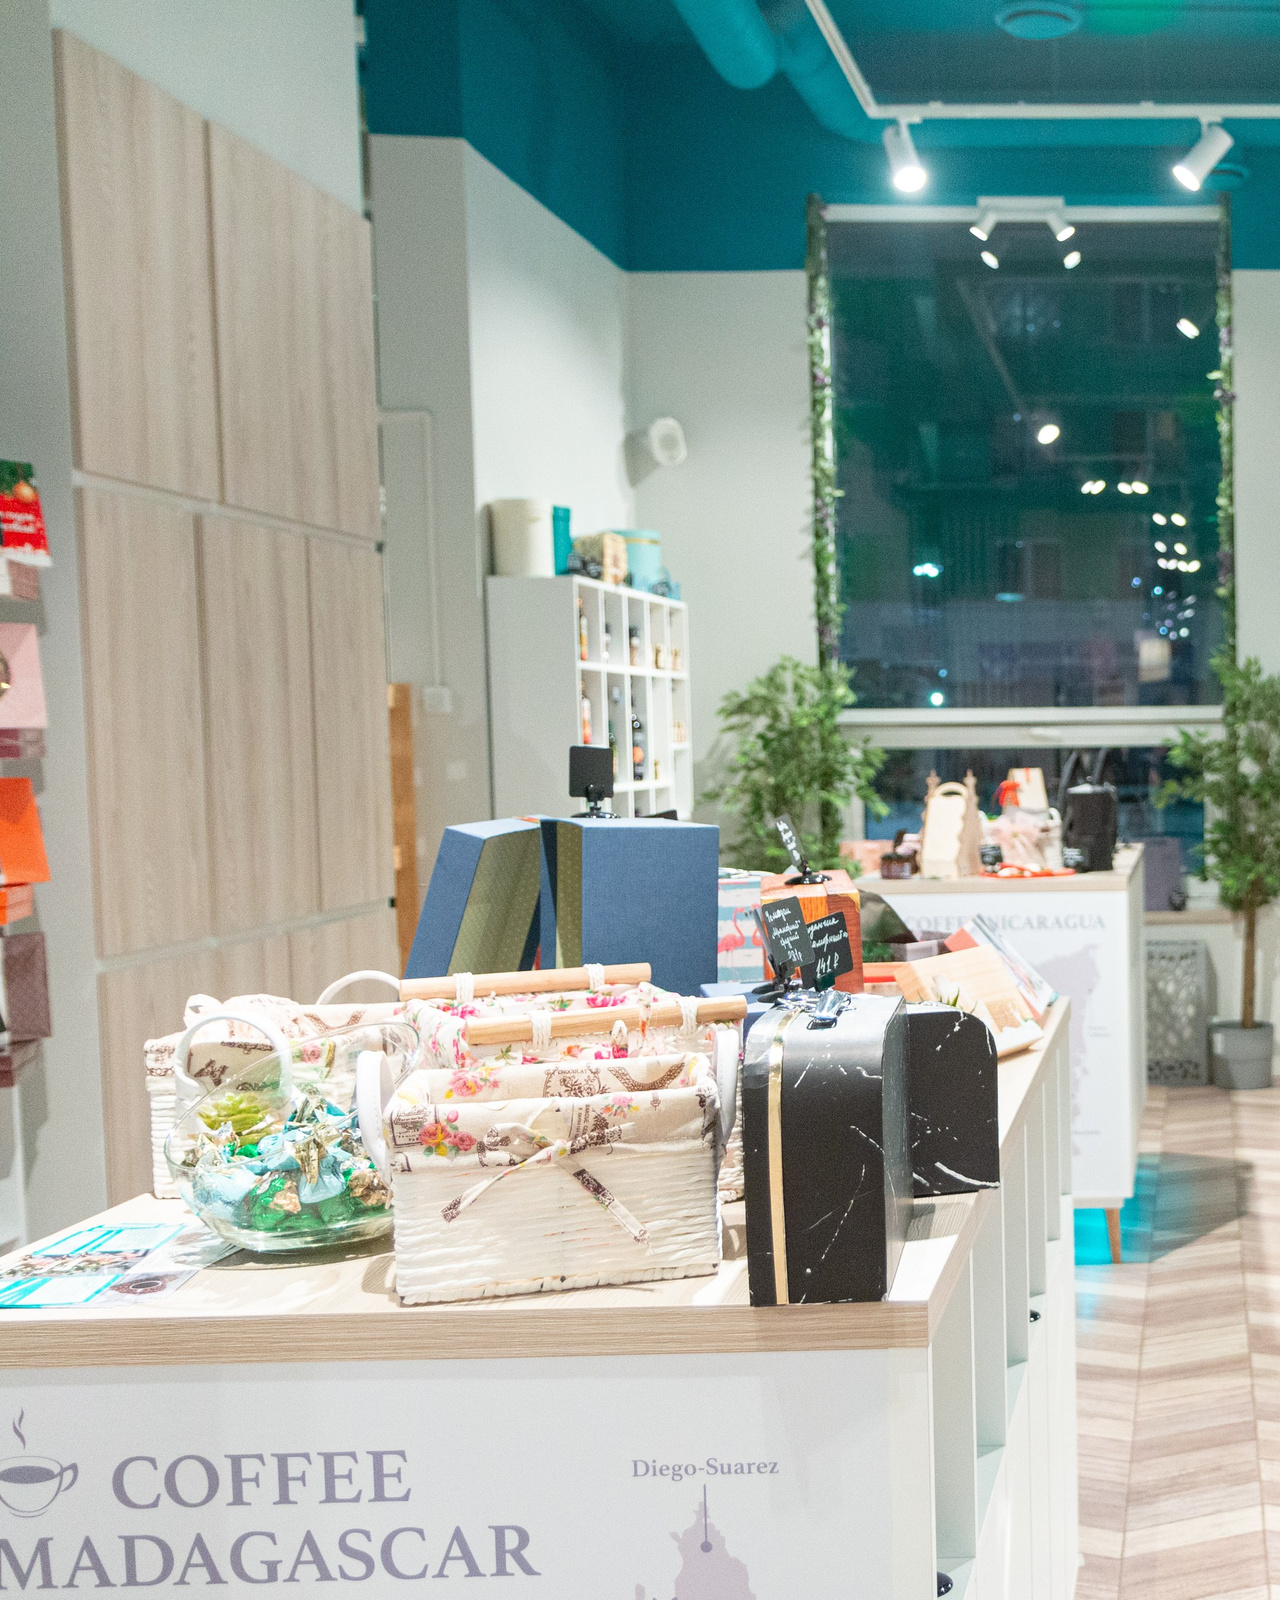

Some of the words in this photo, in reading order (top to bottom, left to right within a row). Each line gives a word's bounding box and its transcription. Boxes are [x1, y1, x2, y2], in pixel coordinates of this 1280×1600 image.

[905, 915, 968, 931] COFFE
[112, 1450, 412, 1509] COFFEE
[631, 1457, 780, 1482] Diego-Suarez
[0, 1525, 541, 1591] MADAGASCAR
